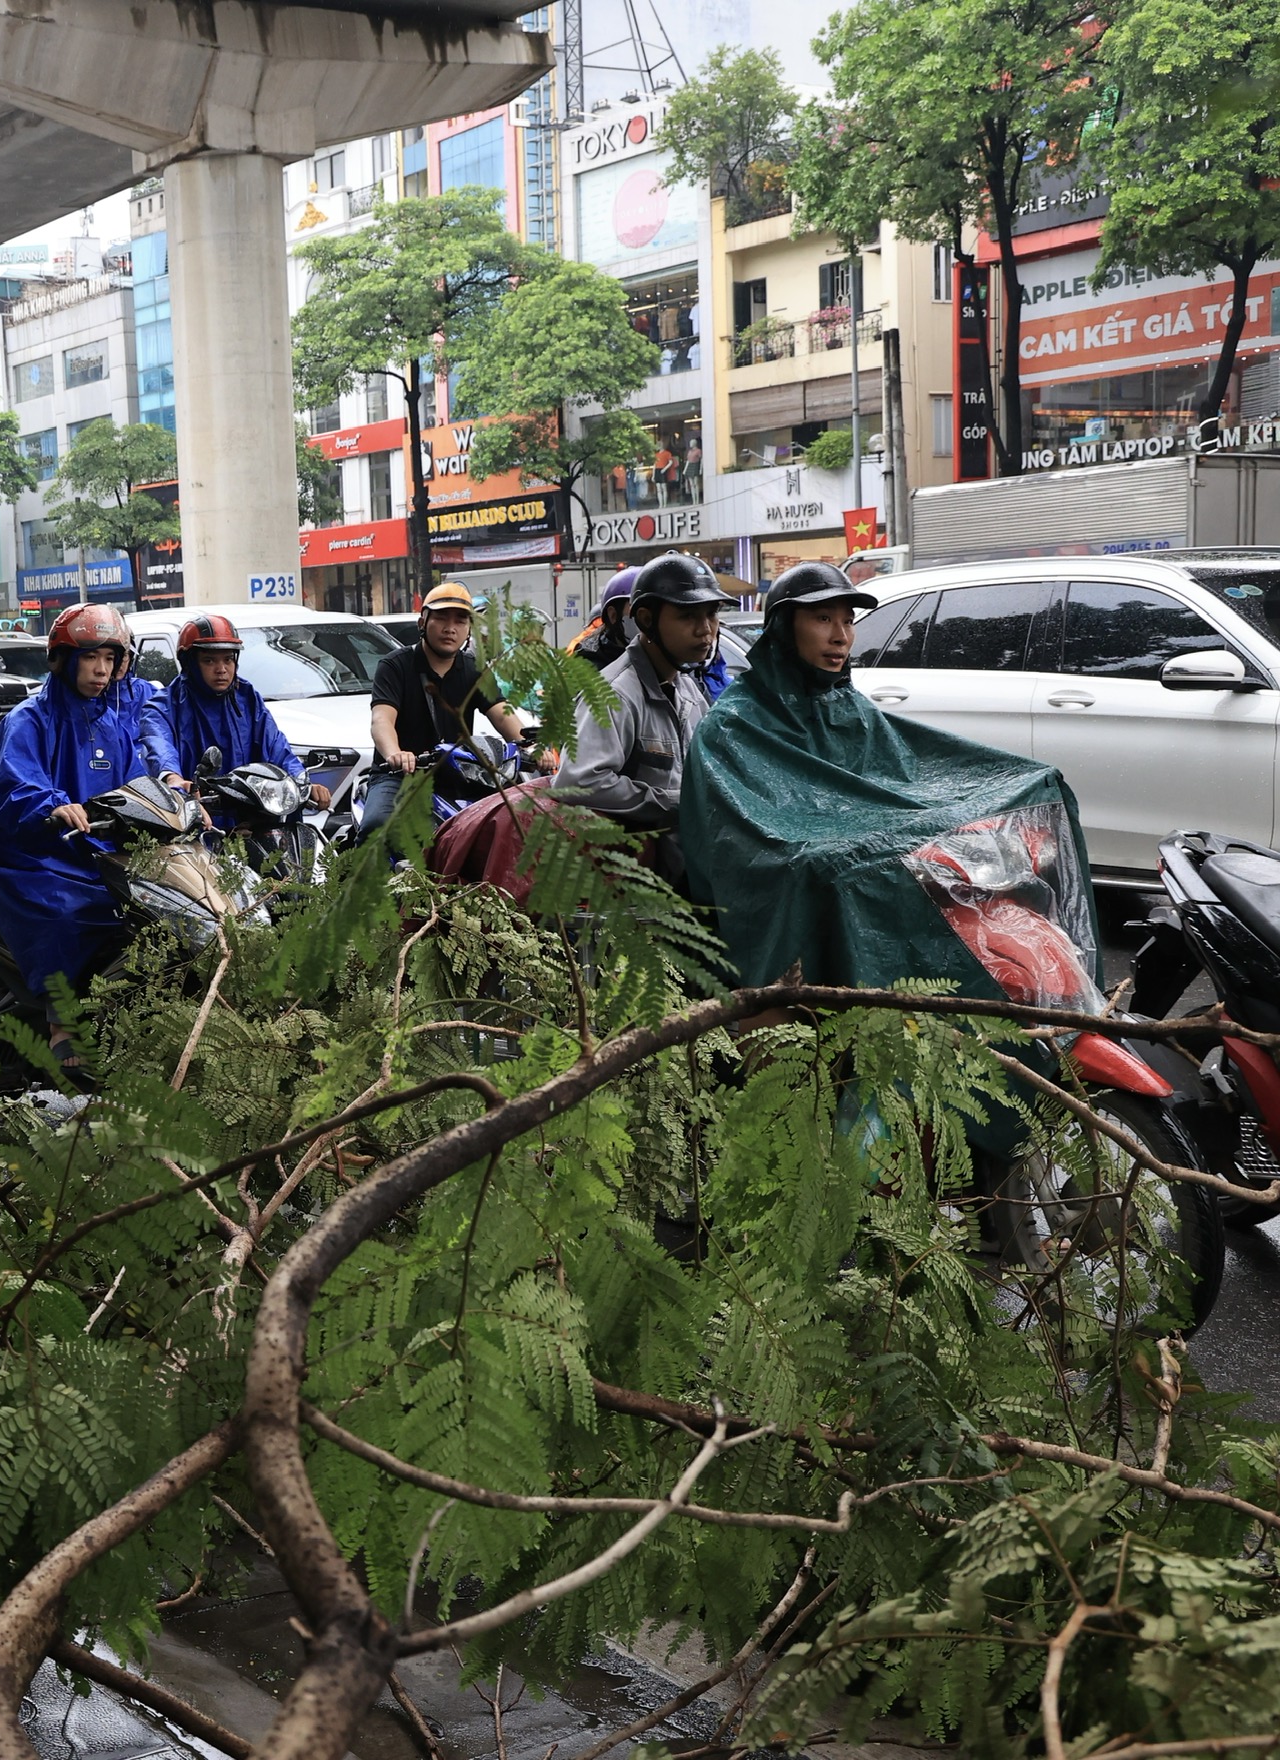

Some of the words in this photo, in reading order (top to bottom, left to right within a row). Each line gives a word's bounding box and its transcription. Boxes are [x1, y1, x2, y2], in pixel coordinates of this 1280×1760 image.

[1021, 275, 1086, 306] APPLE
[1020, 326, 1077, 359] CAM
[1083, 310, 1137, 349] KẾT
[1143, 302, 1194, 339] GIÁ
[963, 422, 987, 439] GÓP
[1058, 441, 1097, 466] TÂM
[1102, 435, 1174, 461] LAPTOP
[438, 506, 508, 532] BILLIARDS
[508, 500, 547, 523] CLUB
[329, 540, 348, 552] pierre
[349, 536, 372, 548] cardin
[23, 575, 41, 592] NHA
[42, 573, 63, 591] KHOA
[100, 566, 122, 585] NAM
[250, 575, 295, 599] P235
